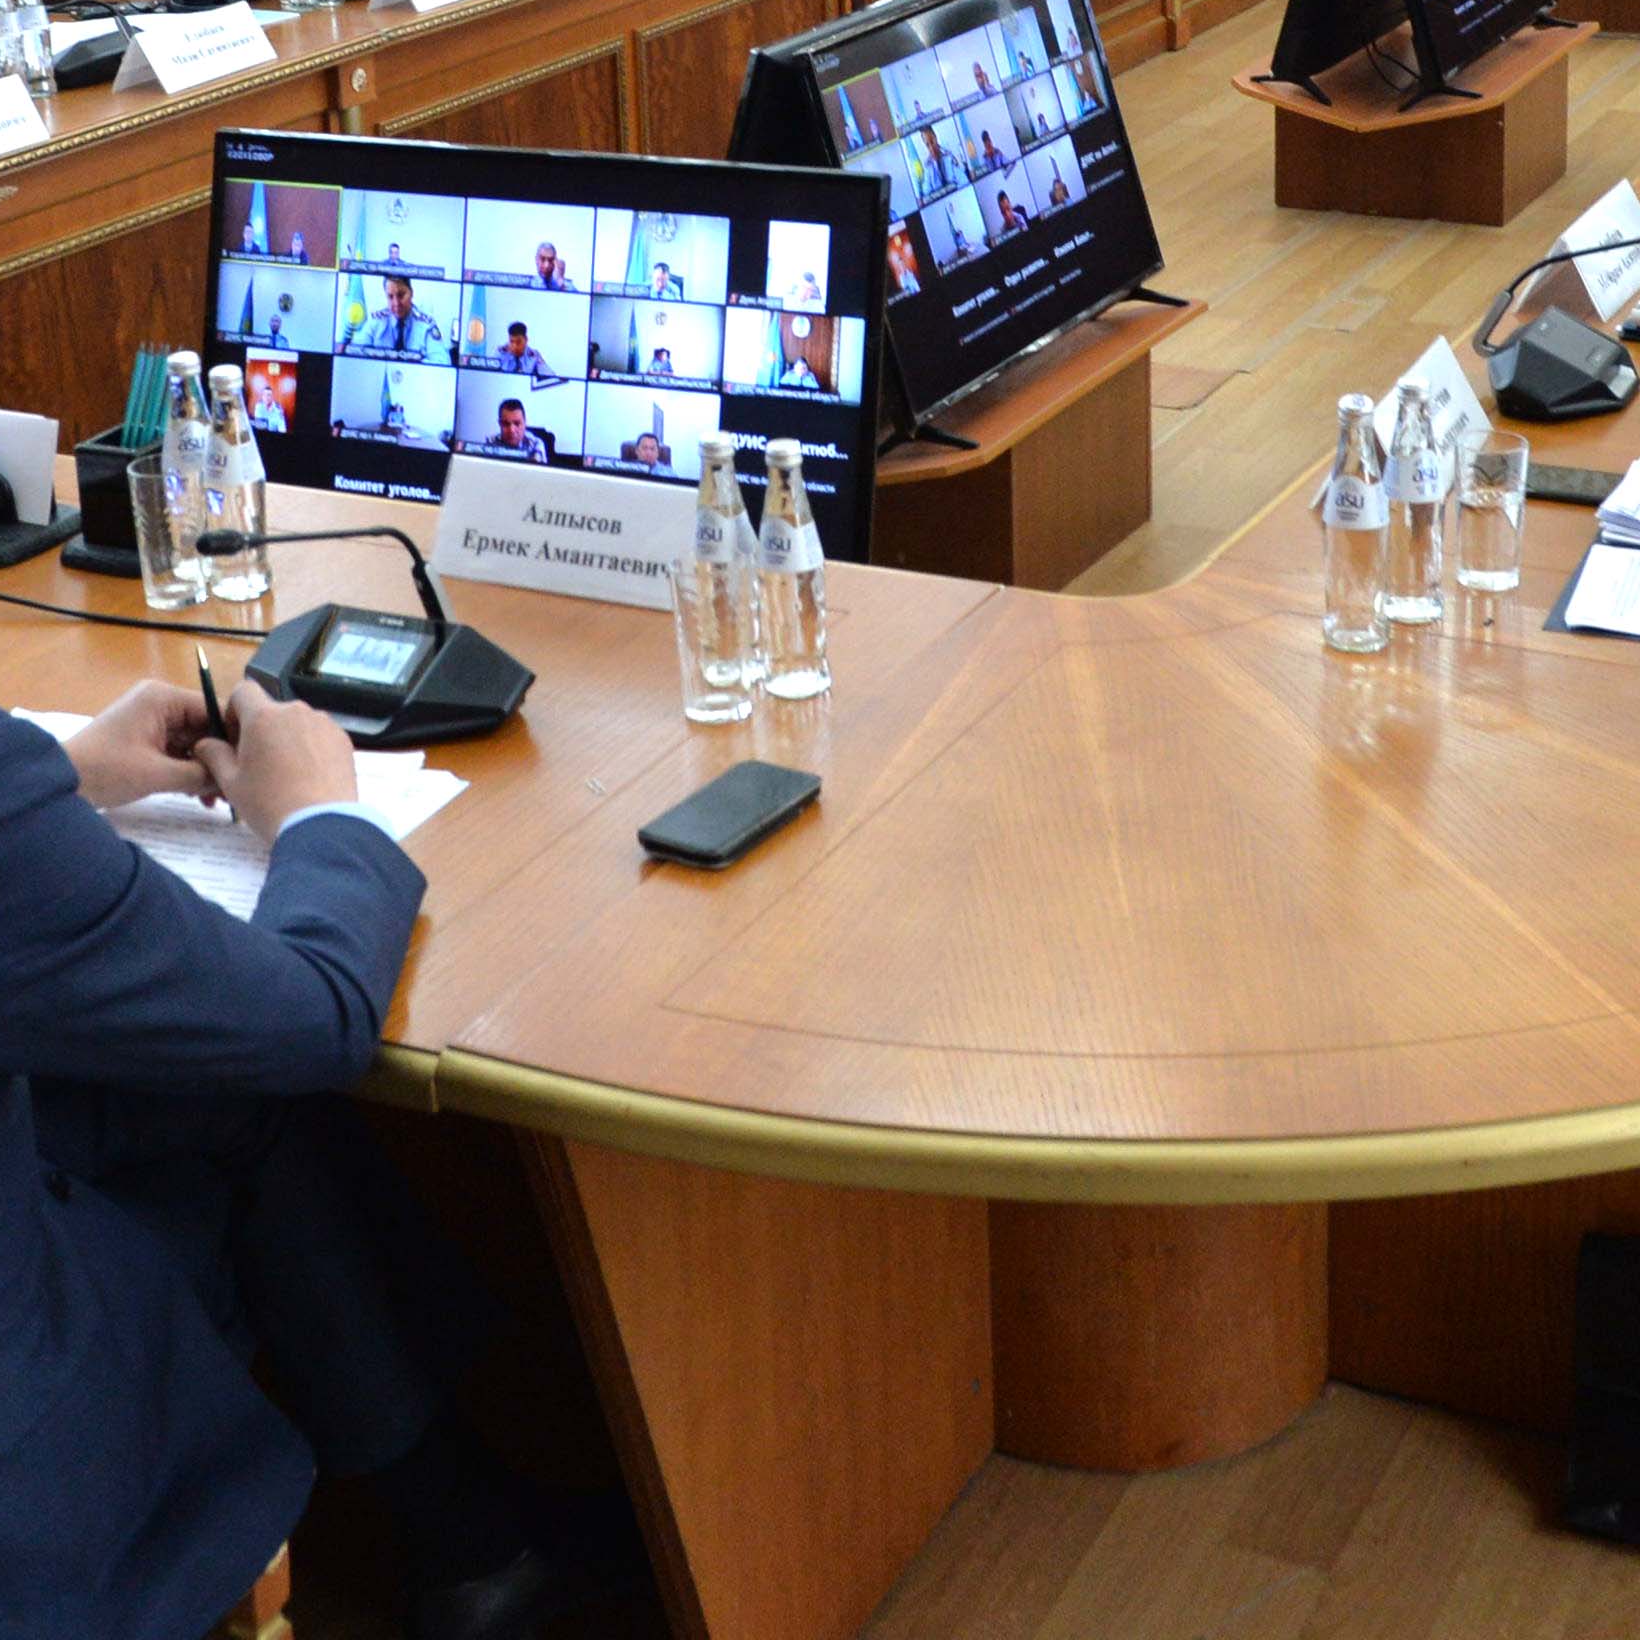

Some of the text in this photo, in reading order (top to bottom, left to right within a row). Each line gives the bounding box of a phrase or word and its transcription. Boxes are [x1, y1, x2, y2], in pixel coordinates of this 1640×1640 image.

[333, 473, 386, 495] Комитет
[521, 502, 623, 536] Алпысов
[461, 526, 531, 559] Ермек
